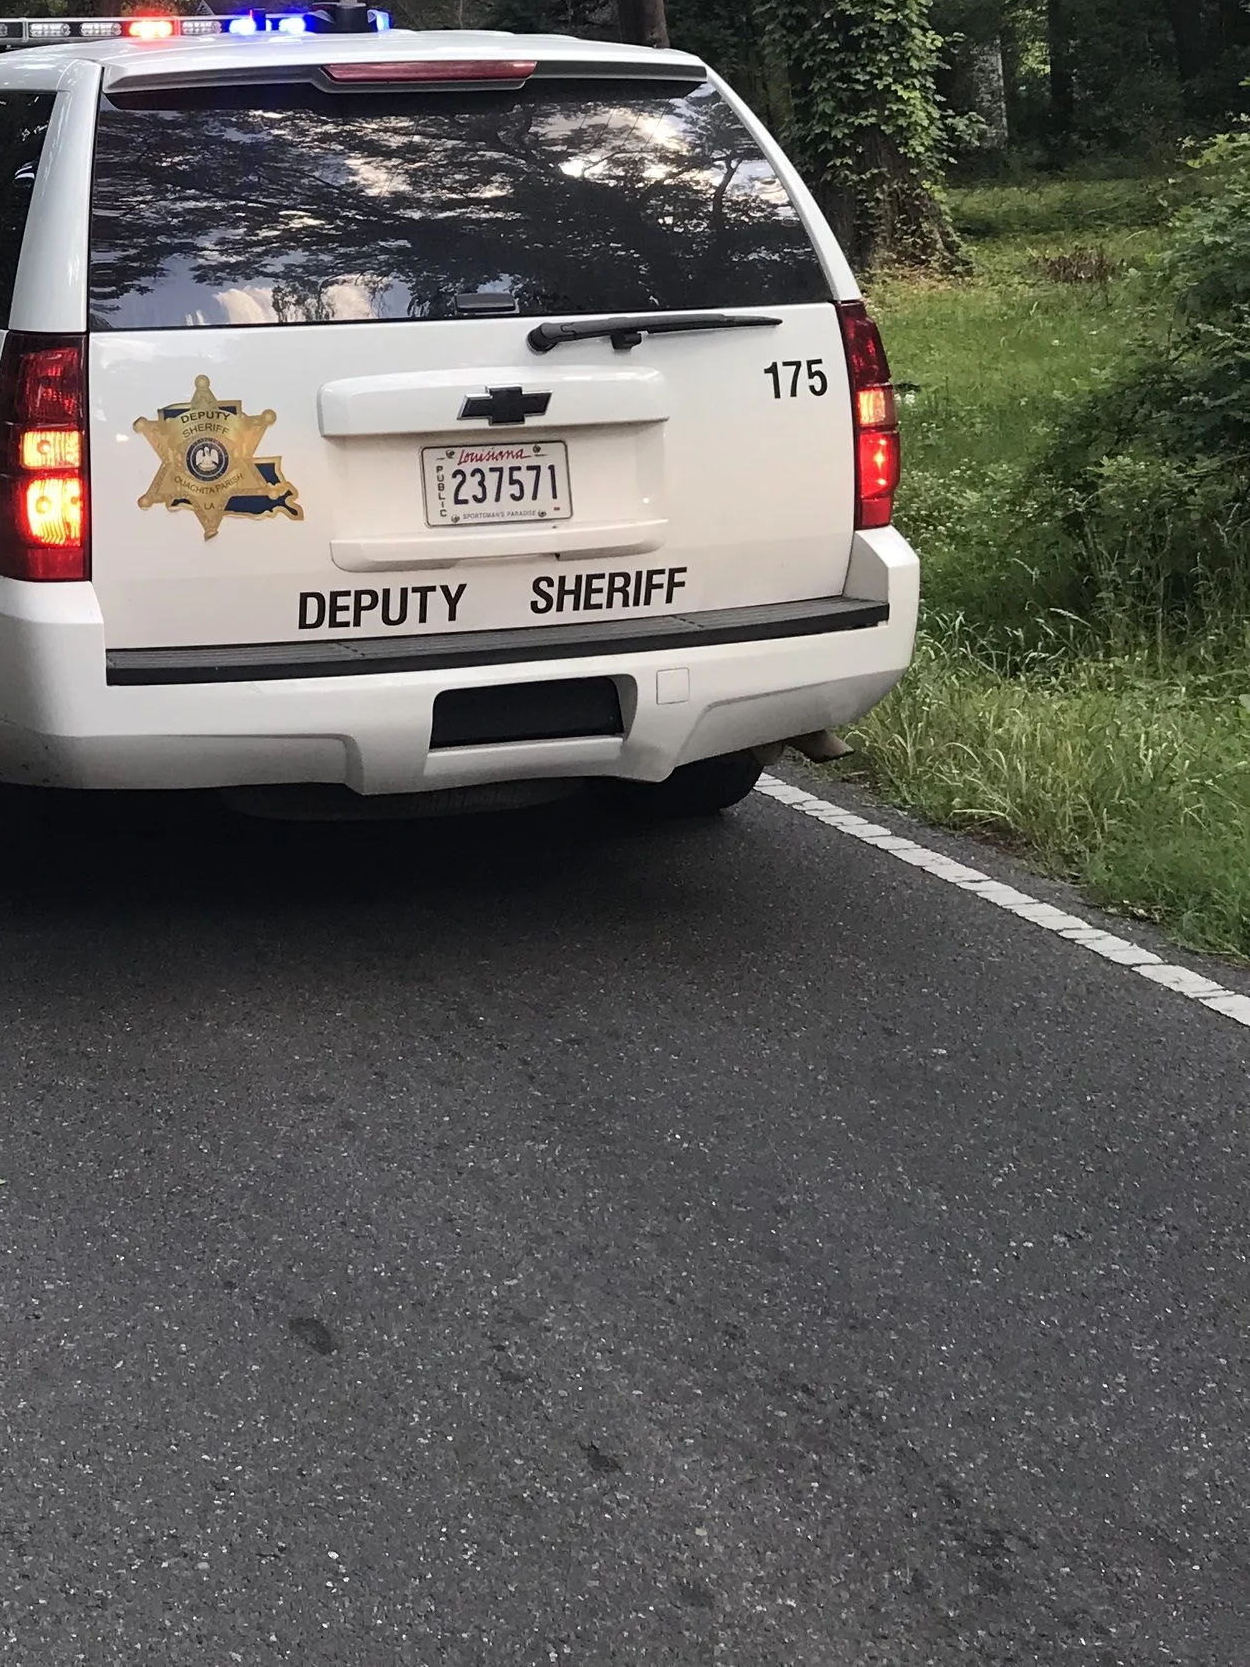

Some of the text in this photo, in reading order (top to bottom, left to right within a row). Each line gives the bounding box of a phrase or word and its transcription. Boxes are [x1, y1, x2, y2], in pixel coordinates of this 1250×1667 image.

[764, 358, 828, 399] 175
[180, 411, 231, 424] DEPUTY
[182, 423, 230, 438] SHERIFF
[457, 448, 532, 465] Louisiana
[174, 472, 244, 494] OUACHITA PARISH
[436, 466, 447, 517] PUBLIC
[451, 465, 557, 505] 237571
[204, 502, 215, 510] LA
[507, 509, 536, 517] PARADISE
[298, 567, 687, 630] DEPUTY SHERIFF
